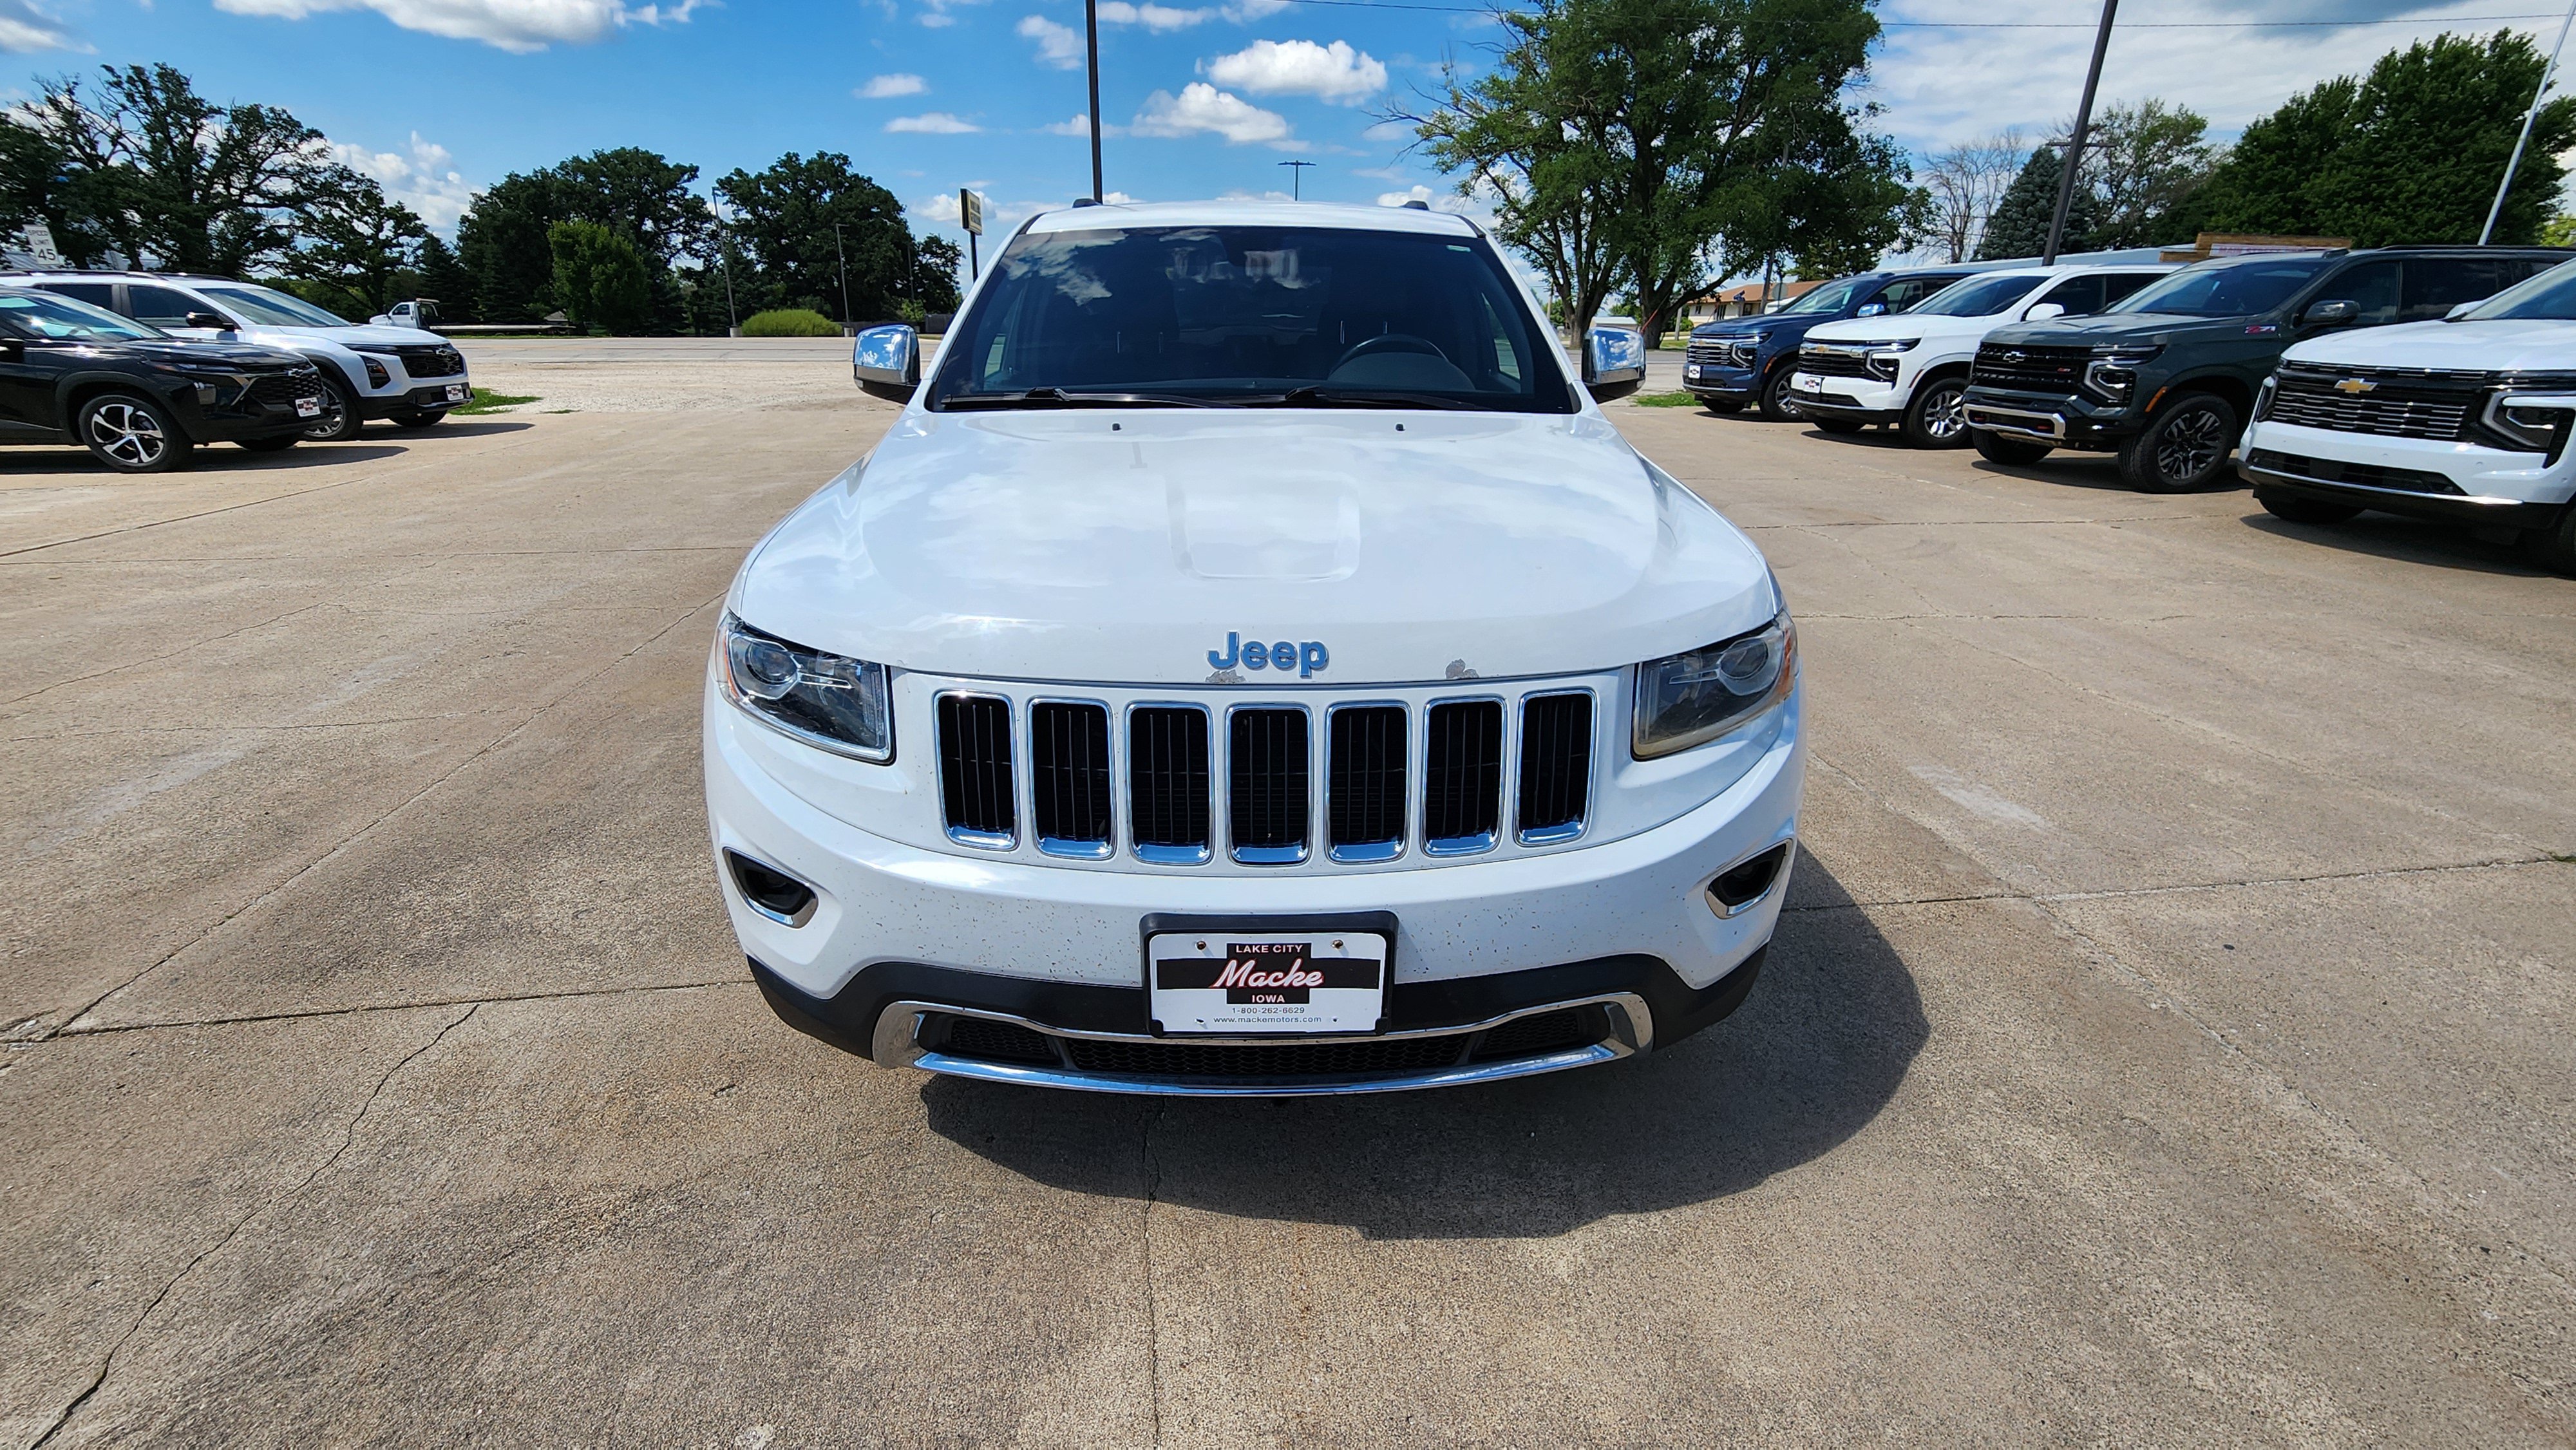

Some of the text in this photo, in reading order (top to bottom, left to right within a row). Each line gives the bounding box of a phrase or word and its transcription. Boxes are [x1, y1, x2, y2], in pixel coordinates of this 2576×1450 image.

[38, 248, 56, 260] 45
[1206, 630, 1330, 679] Jeep
[1235, 944, 1303, 954] LAKE CITY
[1209, 957, 1325, 989] Macke
[1251, 994, 1285, 1003] IOWA
